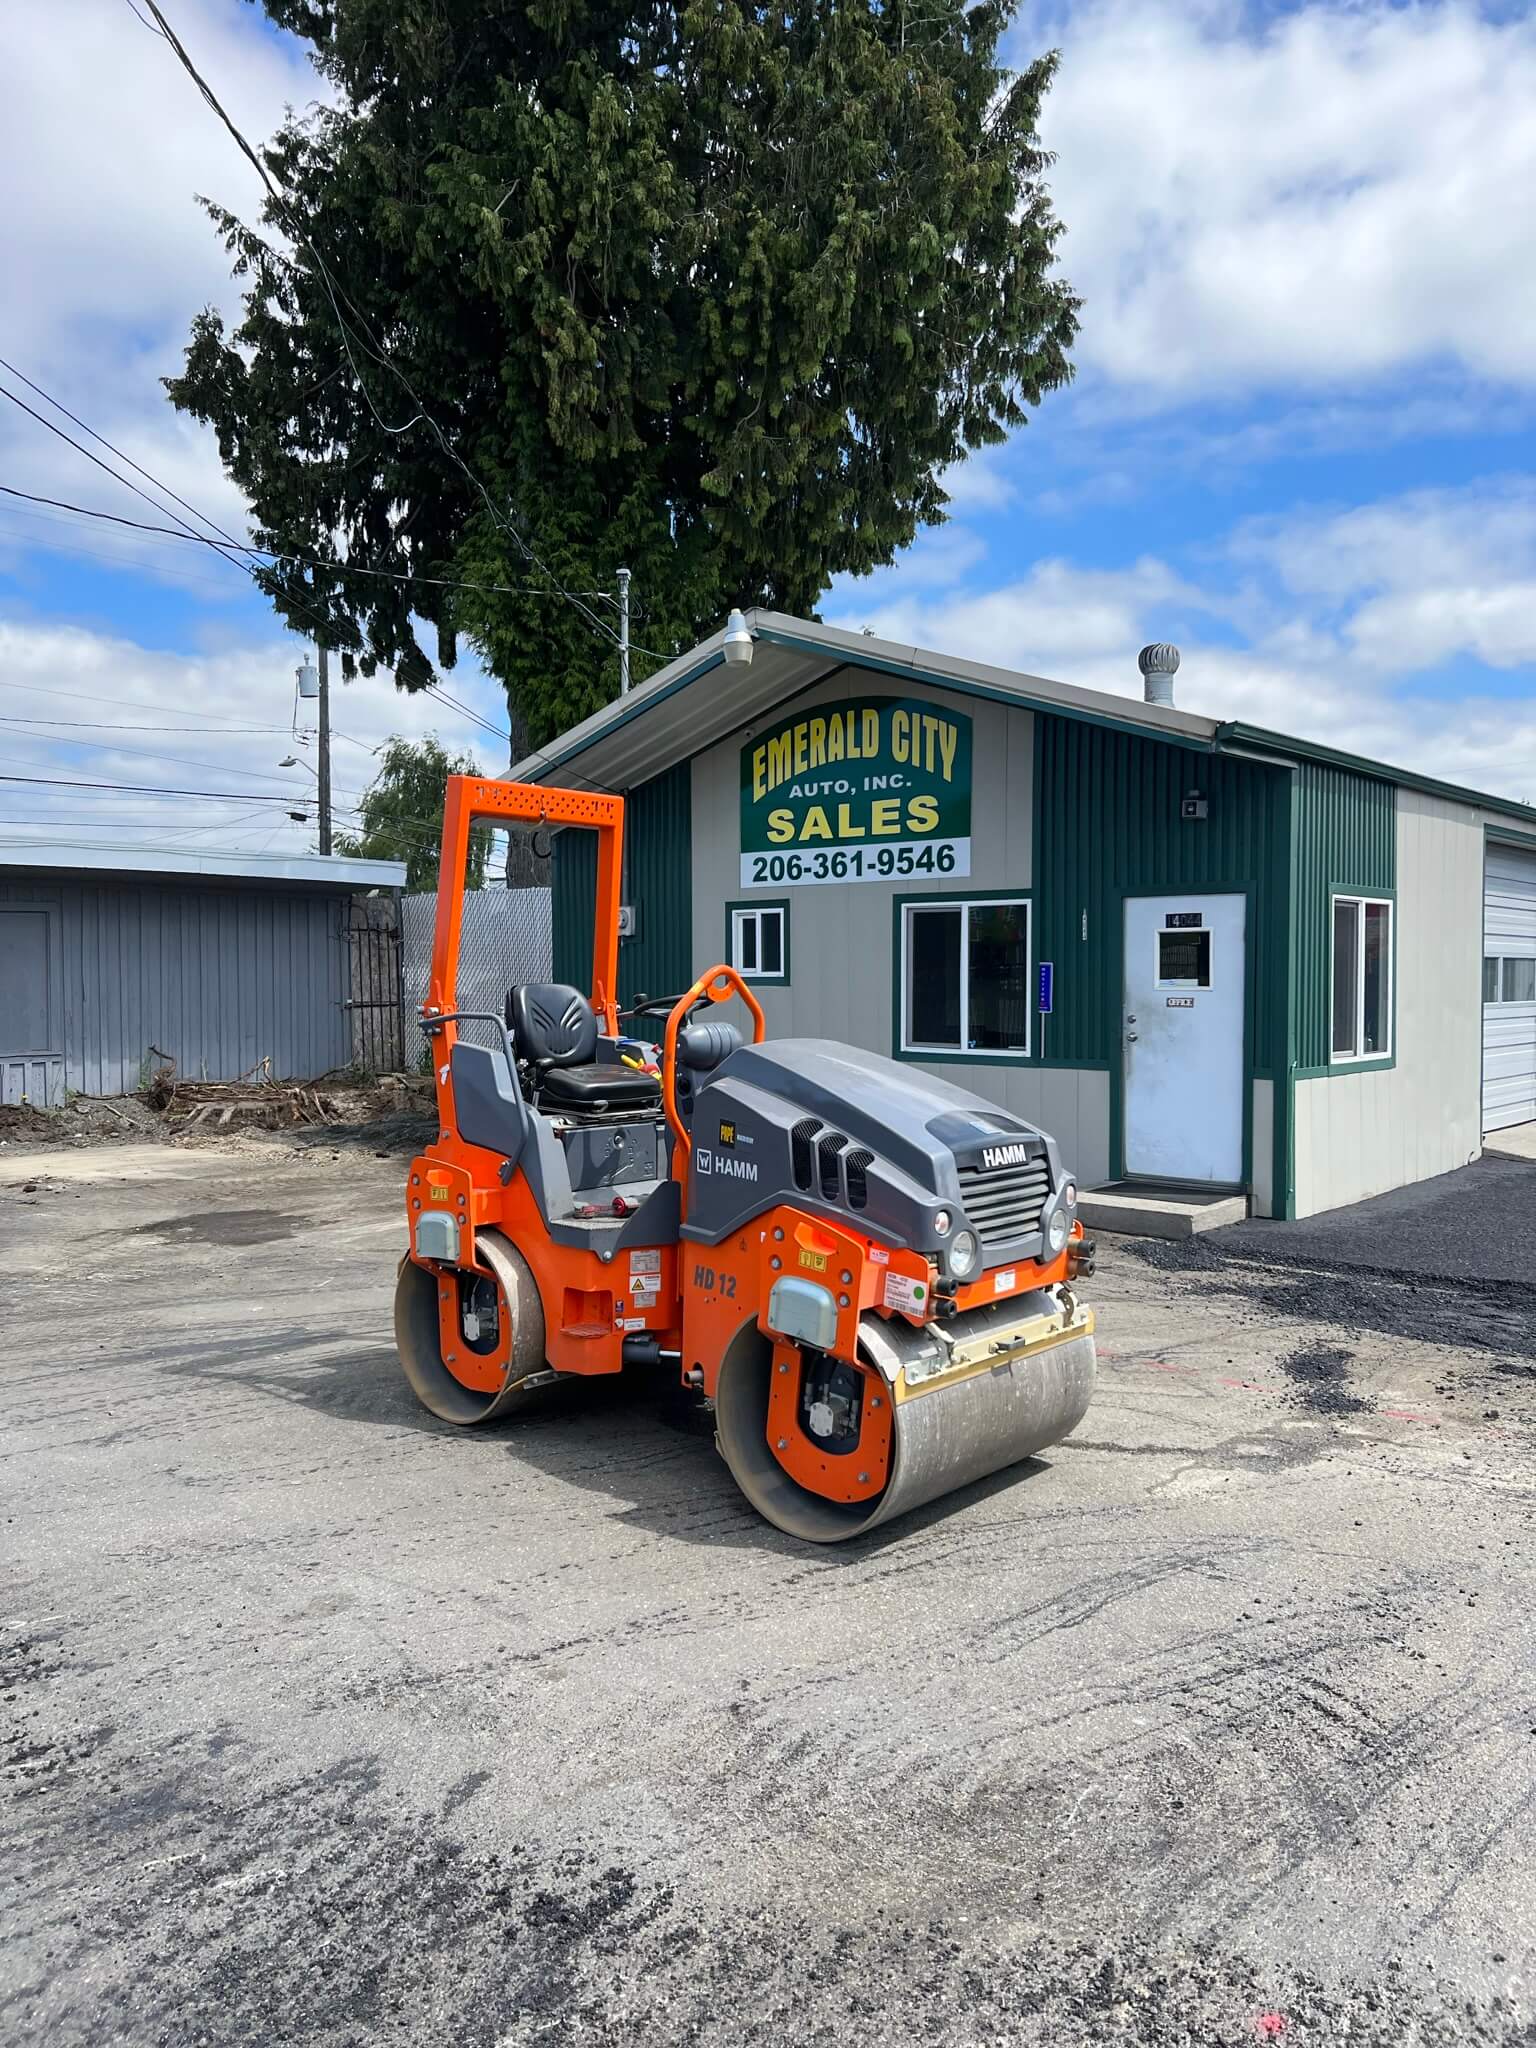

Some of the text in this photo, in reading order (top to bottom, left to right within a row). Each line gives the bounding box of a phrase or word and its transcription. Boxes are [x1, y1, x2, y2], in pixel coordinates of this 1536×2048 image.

[753, 709, 958, 804] EMERALD CITY
[789, 774, 912, 799] AUTO, INC.
[766, 795, 940, 843] SALES
[752, 844, 955, 883] 206-361-9546
[715, 1155, 758, 1182] HAMM
[982, 1144, 1027, 1168] HAMM
[694, 1264, 737, 1299] HD 12
